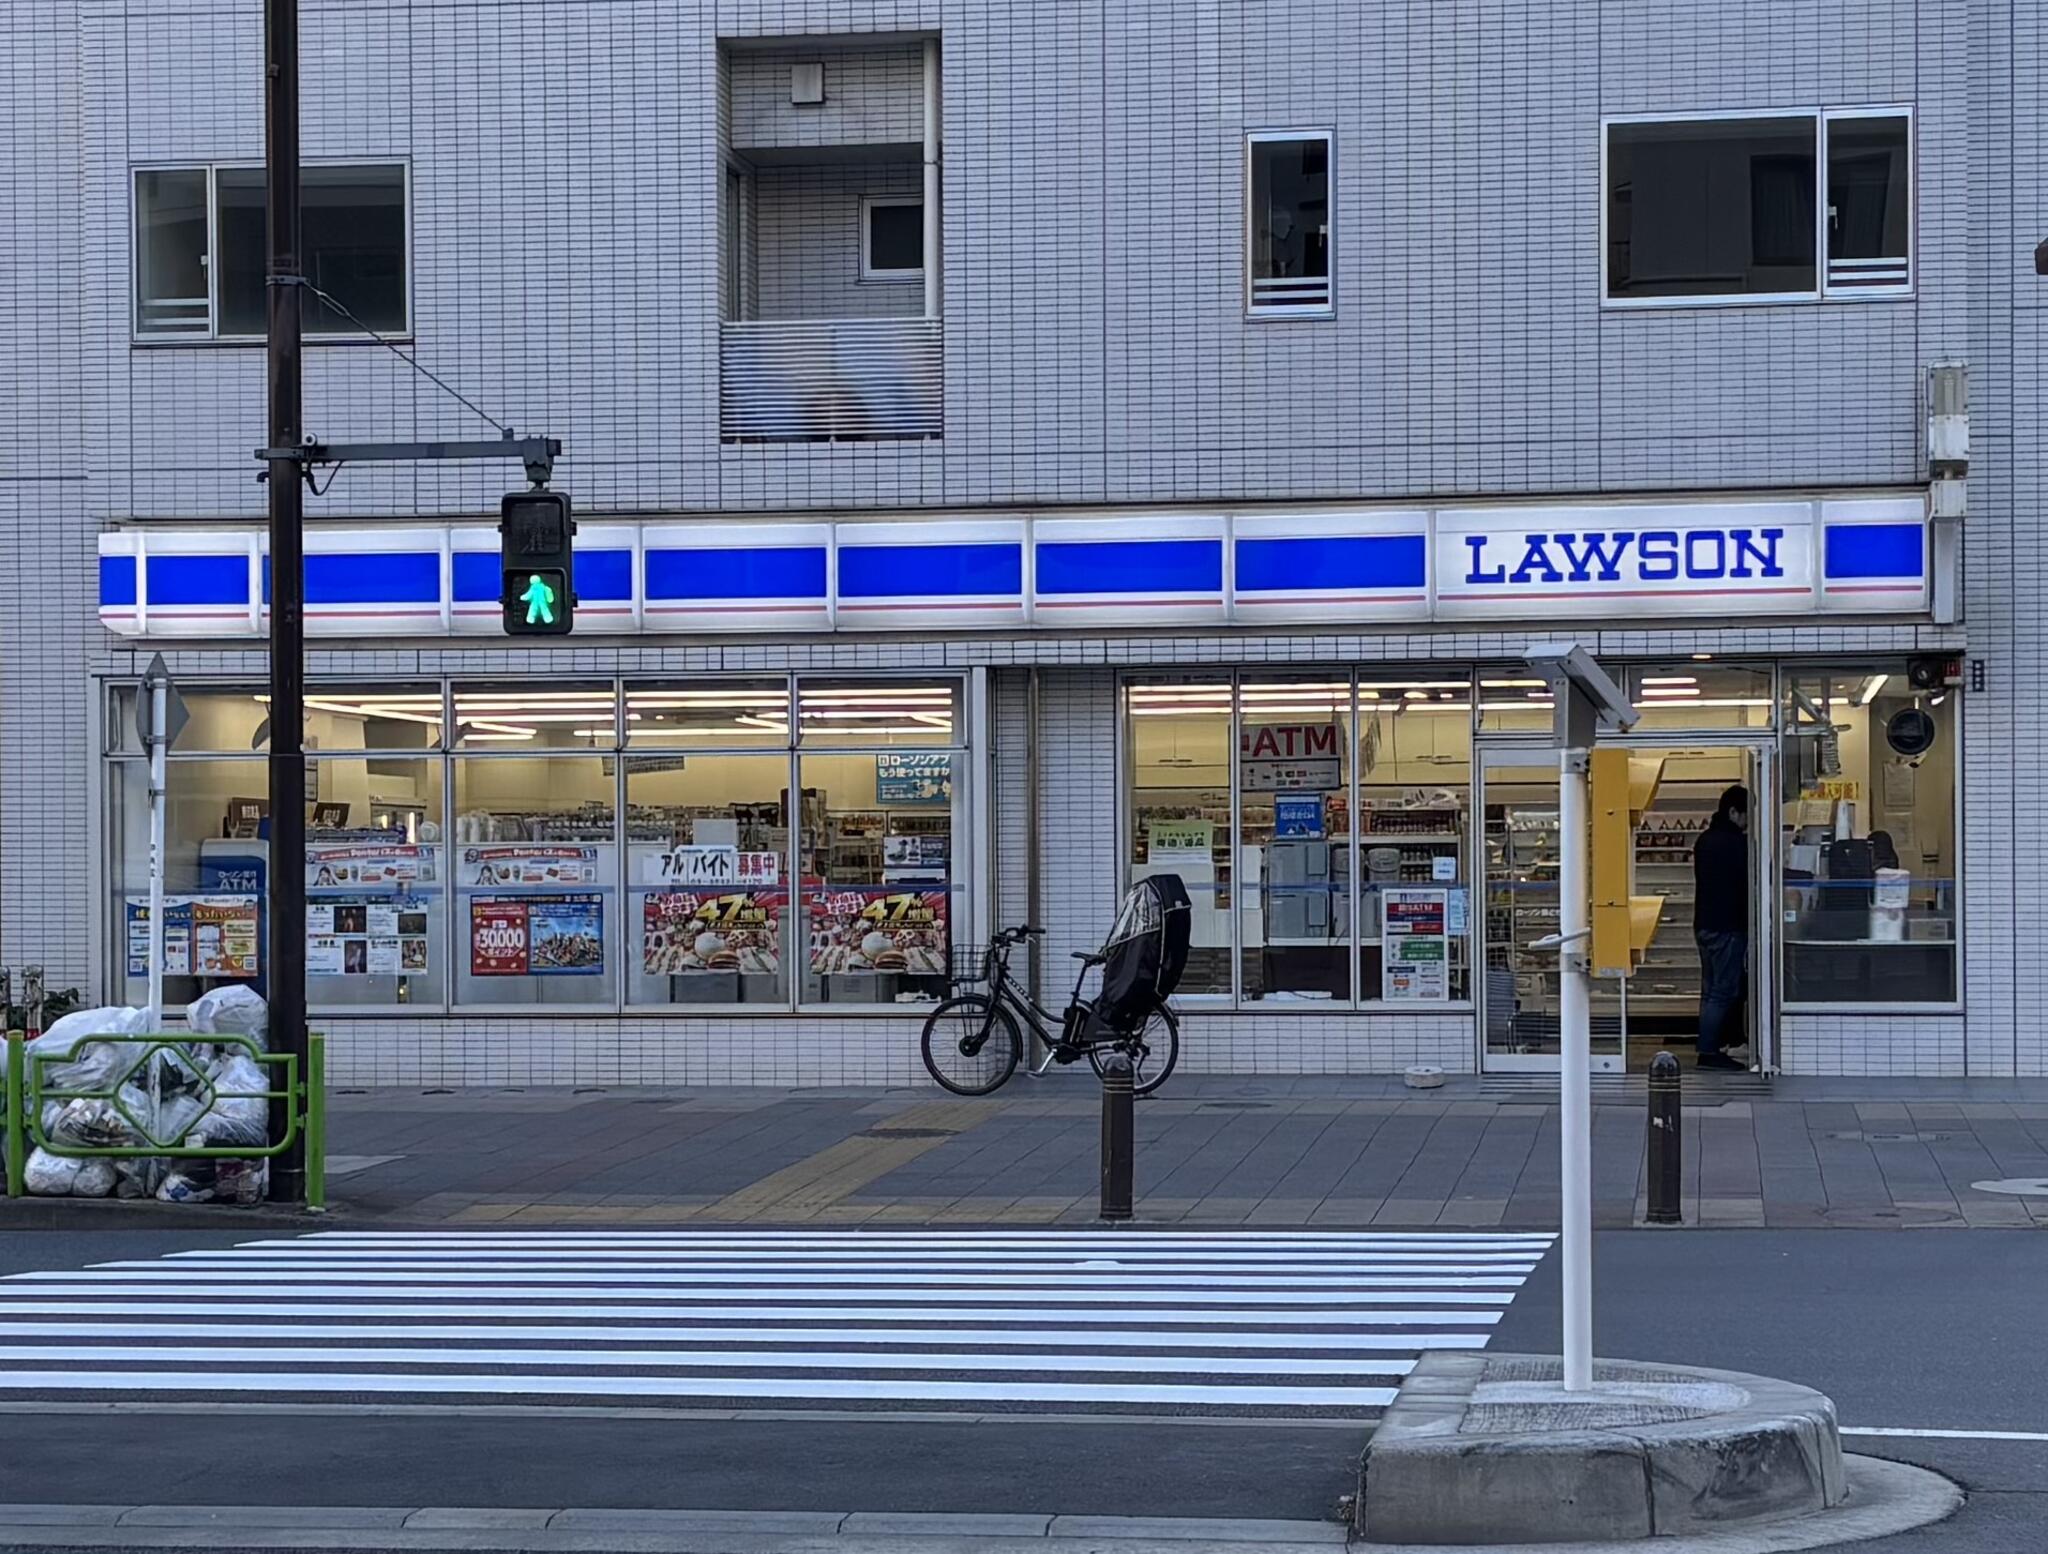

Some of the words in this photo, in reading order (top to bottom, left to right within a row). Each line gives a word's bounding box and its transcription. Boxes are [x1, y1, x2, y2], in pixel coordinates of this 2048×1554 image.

[1465, 528, 1784, 584] LAWSON
[1252, 725, 1337, 757] ATM
[219, 878, 257, 891] ATM
